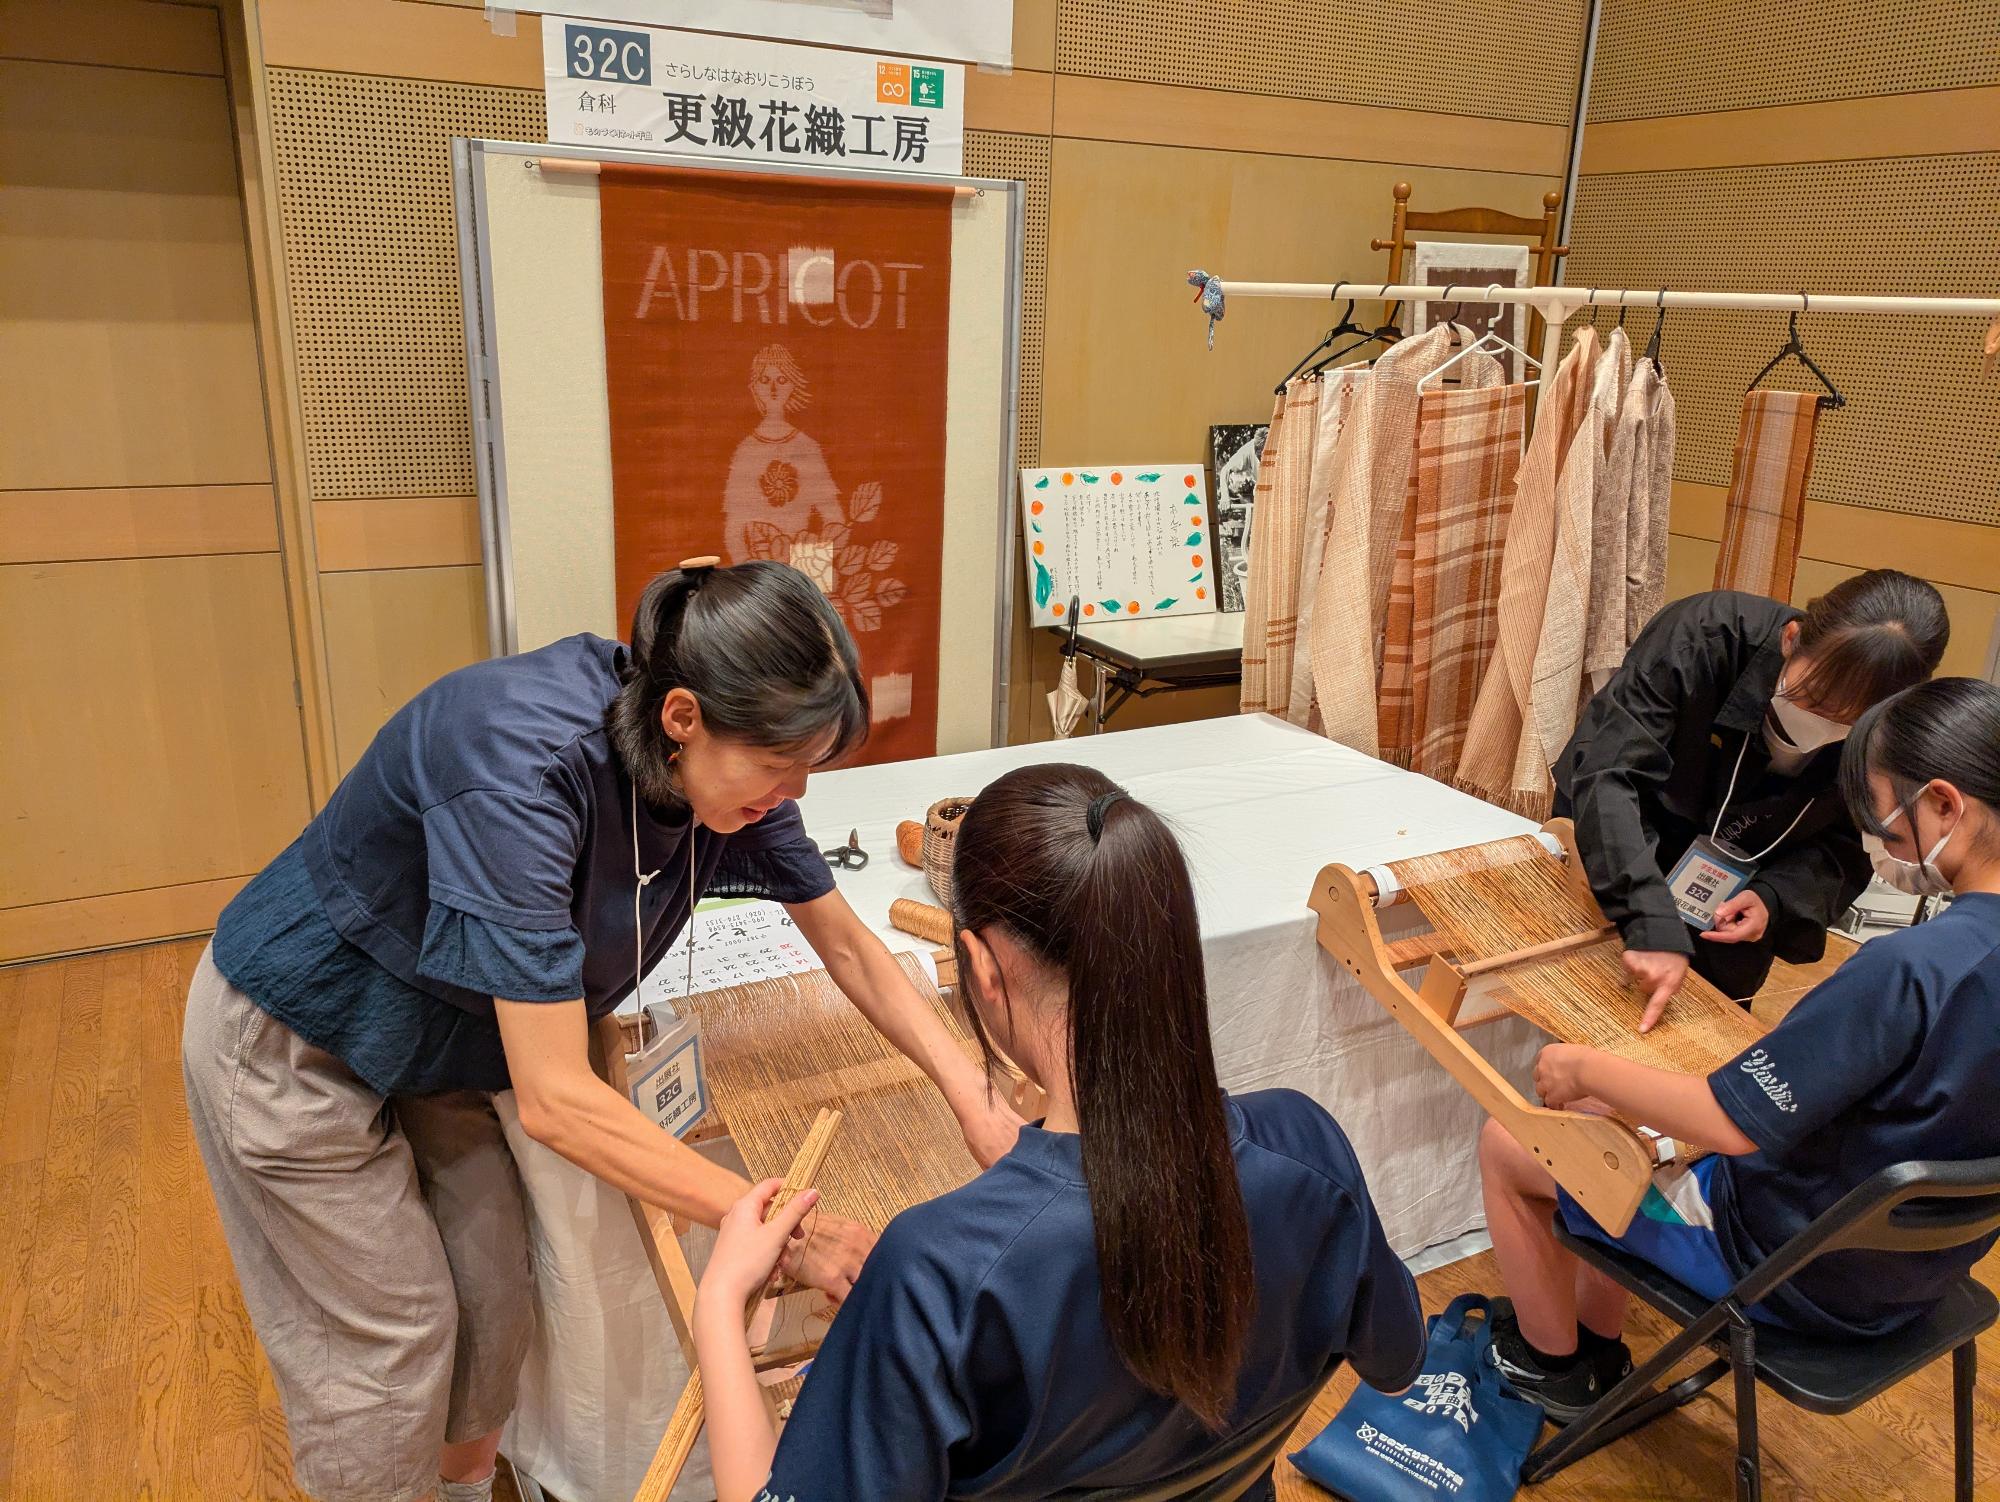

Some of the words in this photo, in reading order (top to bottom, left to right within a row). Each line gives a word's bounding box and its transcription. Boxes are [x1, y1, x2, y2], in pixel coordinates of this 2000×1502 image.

[573, 35, 645, 81] 32C
[879, 65, 886, 75] 12
[665, 62, 815, 92] さらしなはなおりこうぼう
[913, 69, 920, 79] 15
[578, 91, 617, 114] 倉科
[662, 91, 930, 163] 更級花織工房
[635, 246, 924, 329] APRICOT
[1688, 886, 1709, 901] 32C
[1673, 896, 1710, 921] 級花織工房
[658, 978, 670, 986] 27
[659, 1083, 680, 1107] 32C
[659, 1091, 697, 1129] 花織工房
[1432, 1394, 1460, 1405] 千曲
